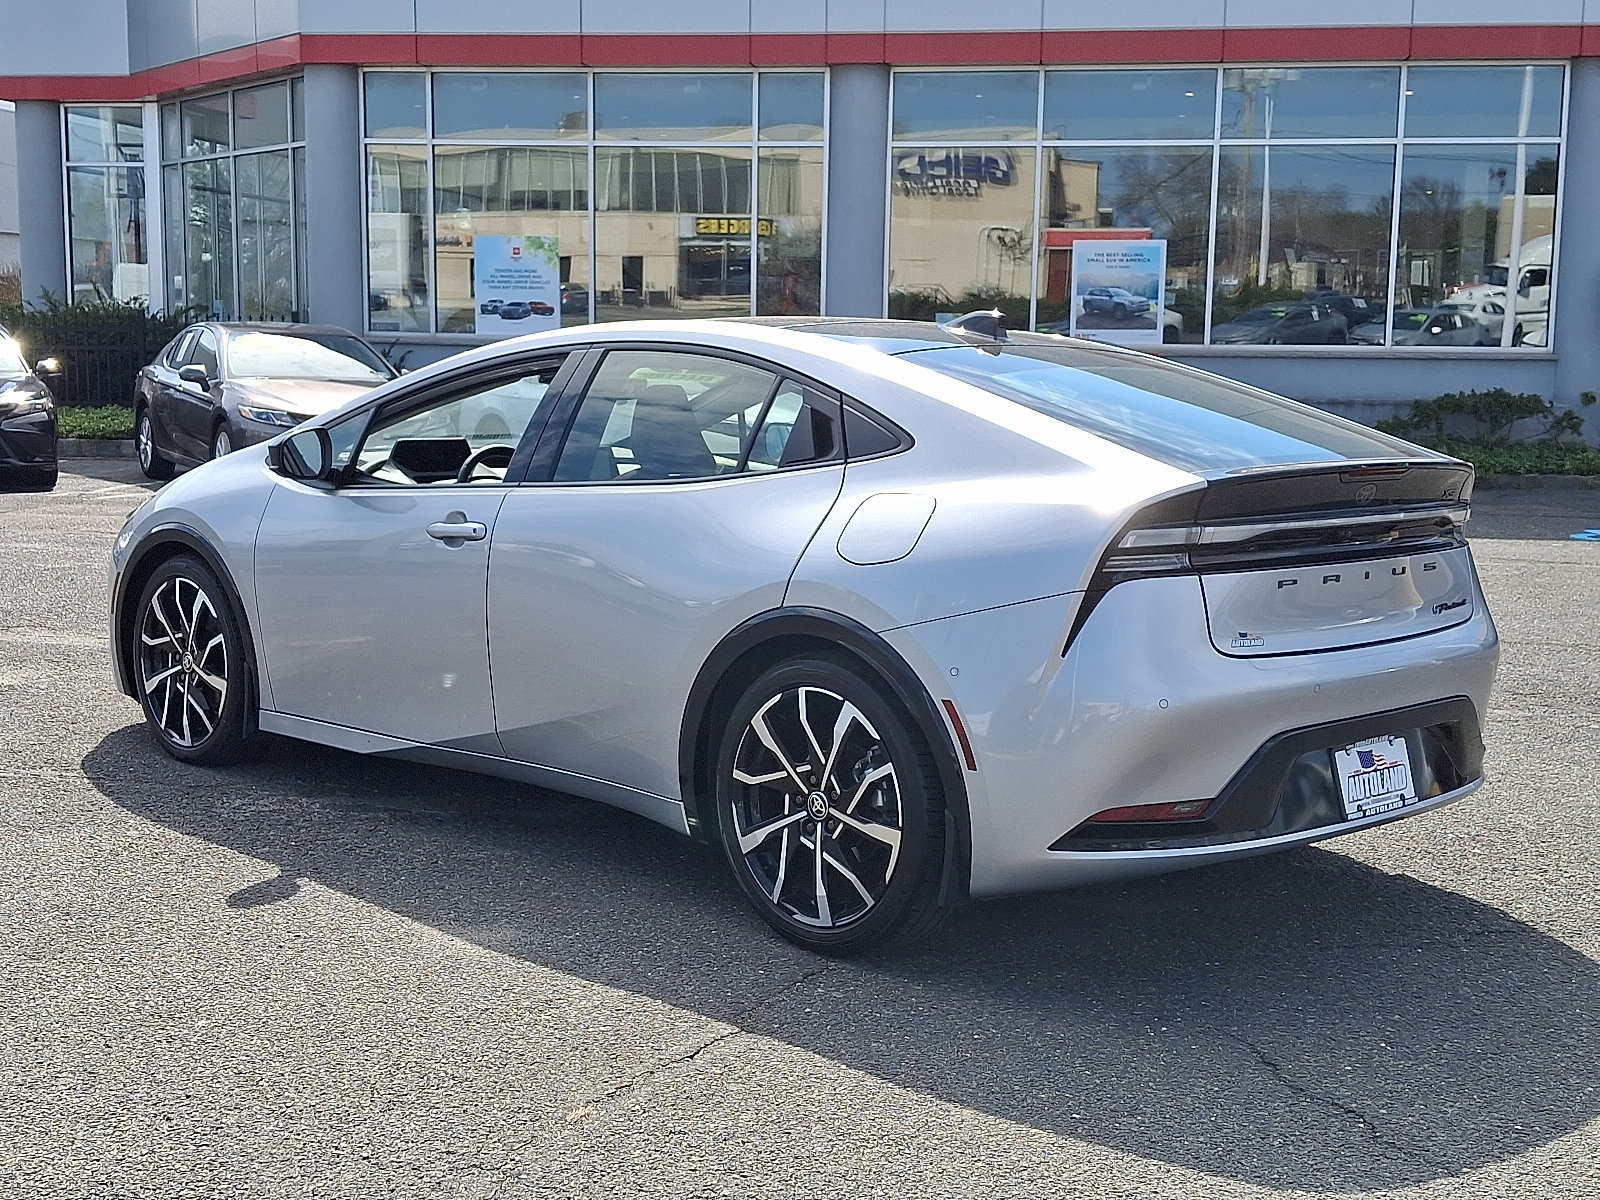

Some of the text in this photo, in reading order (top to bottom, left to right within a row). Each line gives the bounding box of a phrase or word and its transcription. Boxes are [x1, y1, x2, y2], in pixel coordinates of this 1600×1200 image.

[1277, 561, 1438, 589] PRIUS
[1348, 764, 1407, 804] AUTOLAND
[1365, 801, 1403, 816] AUTOLAND
